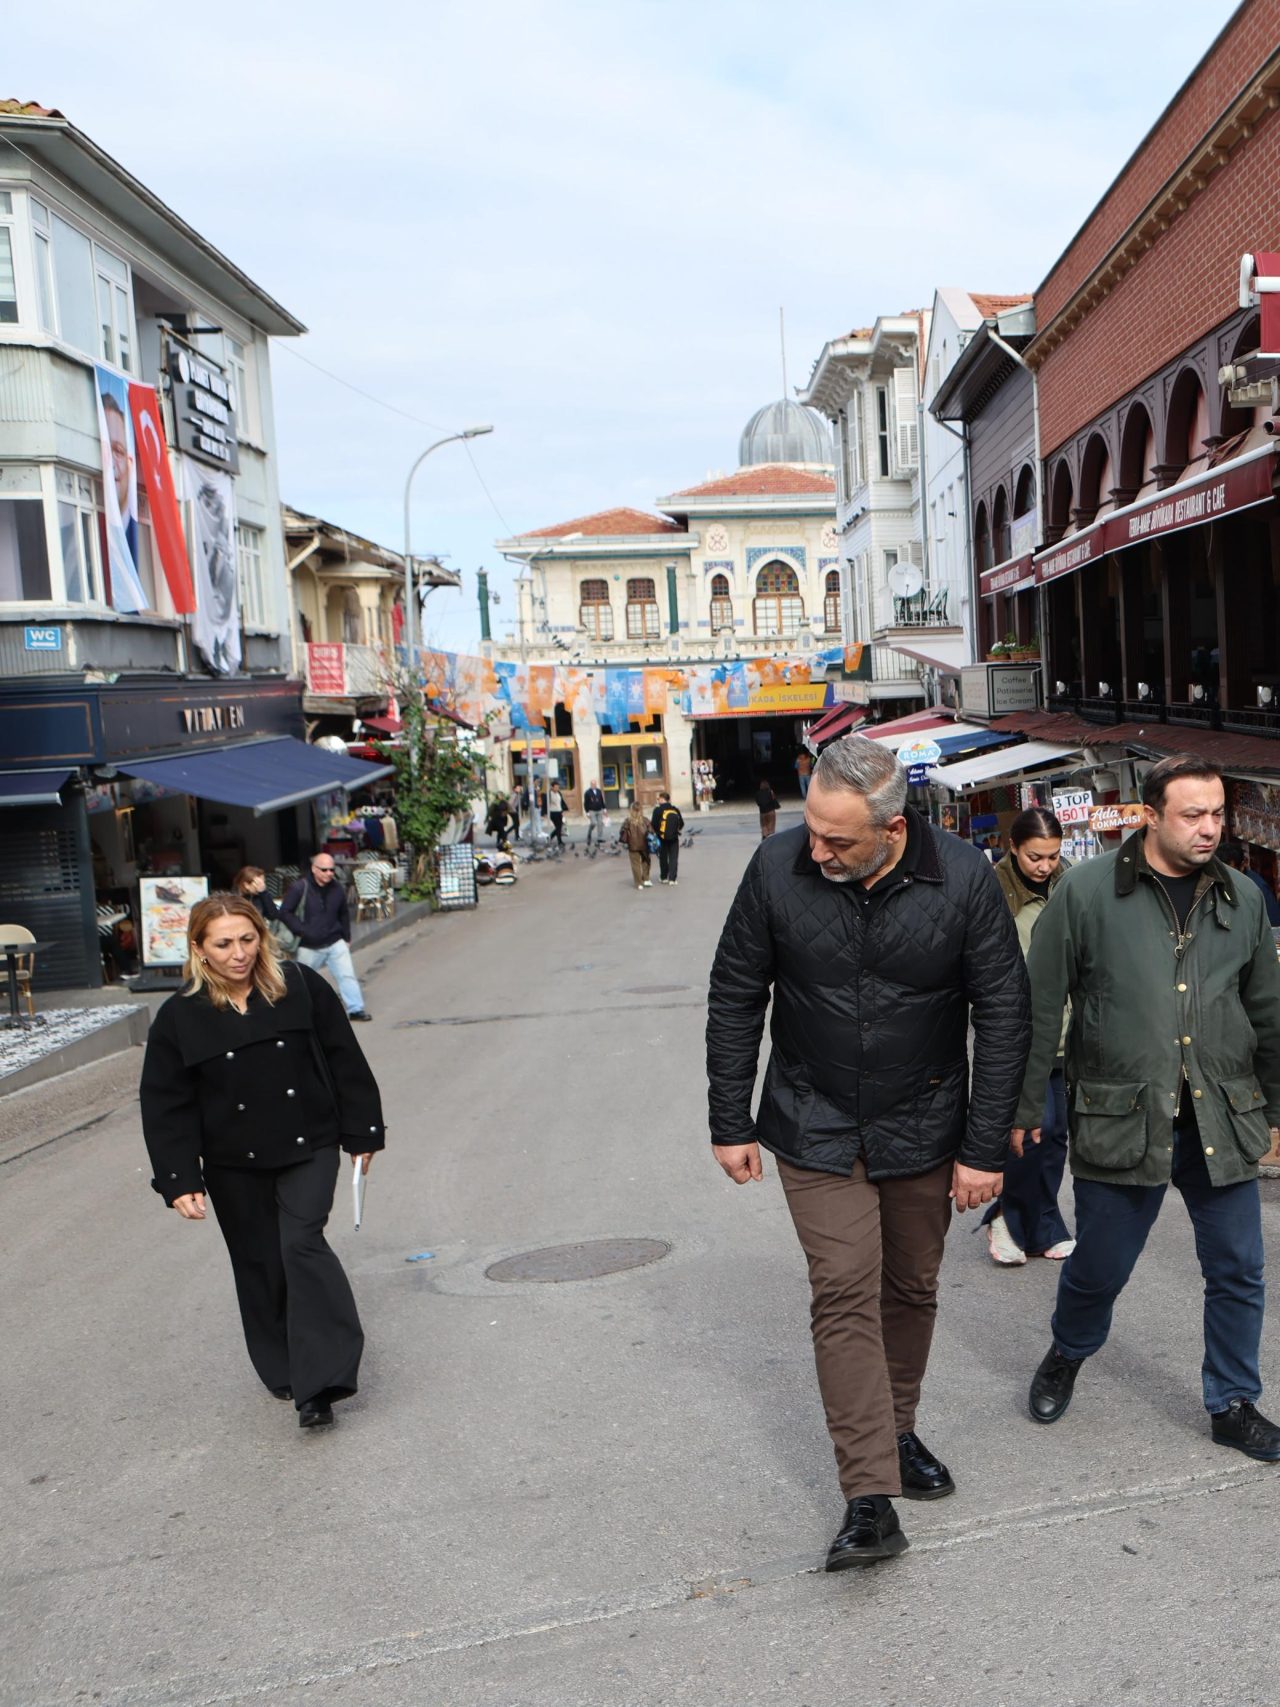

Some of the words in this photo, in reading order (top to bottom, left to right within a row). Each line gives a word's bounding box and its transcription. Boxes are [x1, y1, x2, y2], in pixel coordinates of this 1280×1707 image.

[30, 630, 56, 641] WC
[1001, 676, 1026, 684] Coffee
[1055, 798, 1062, 809] 3
[1065, 793, 1090, 807] TOP
[1056, 808, 1078, 823] 150
[1091, 806, 1120, 821] Ada
[1092, 815, 1141, 830] LOKMACISI
